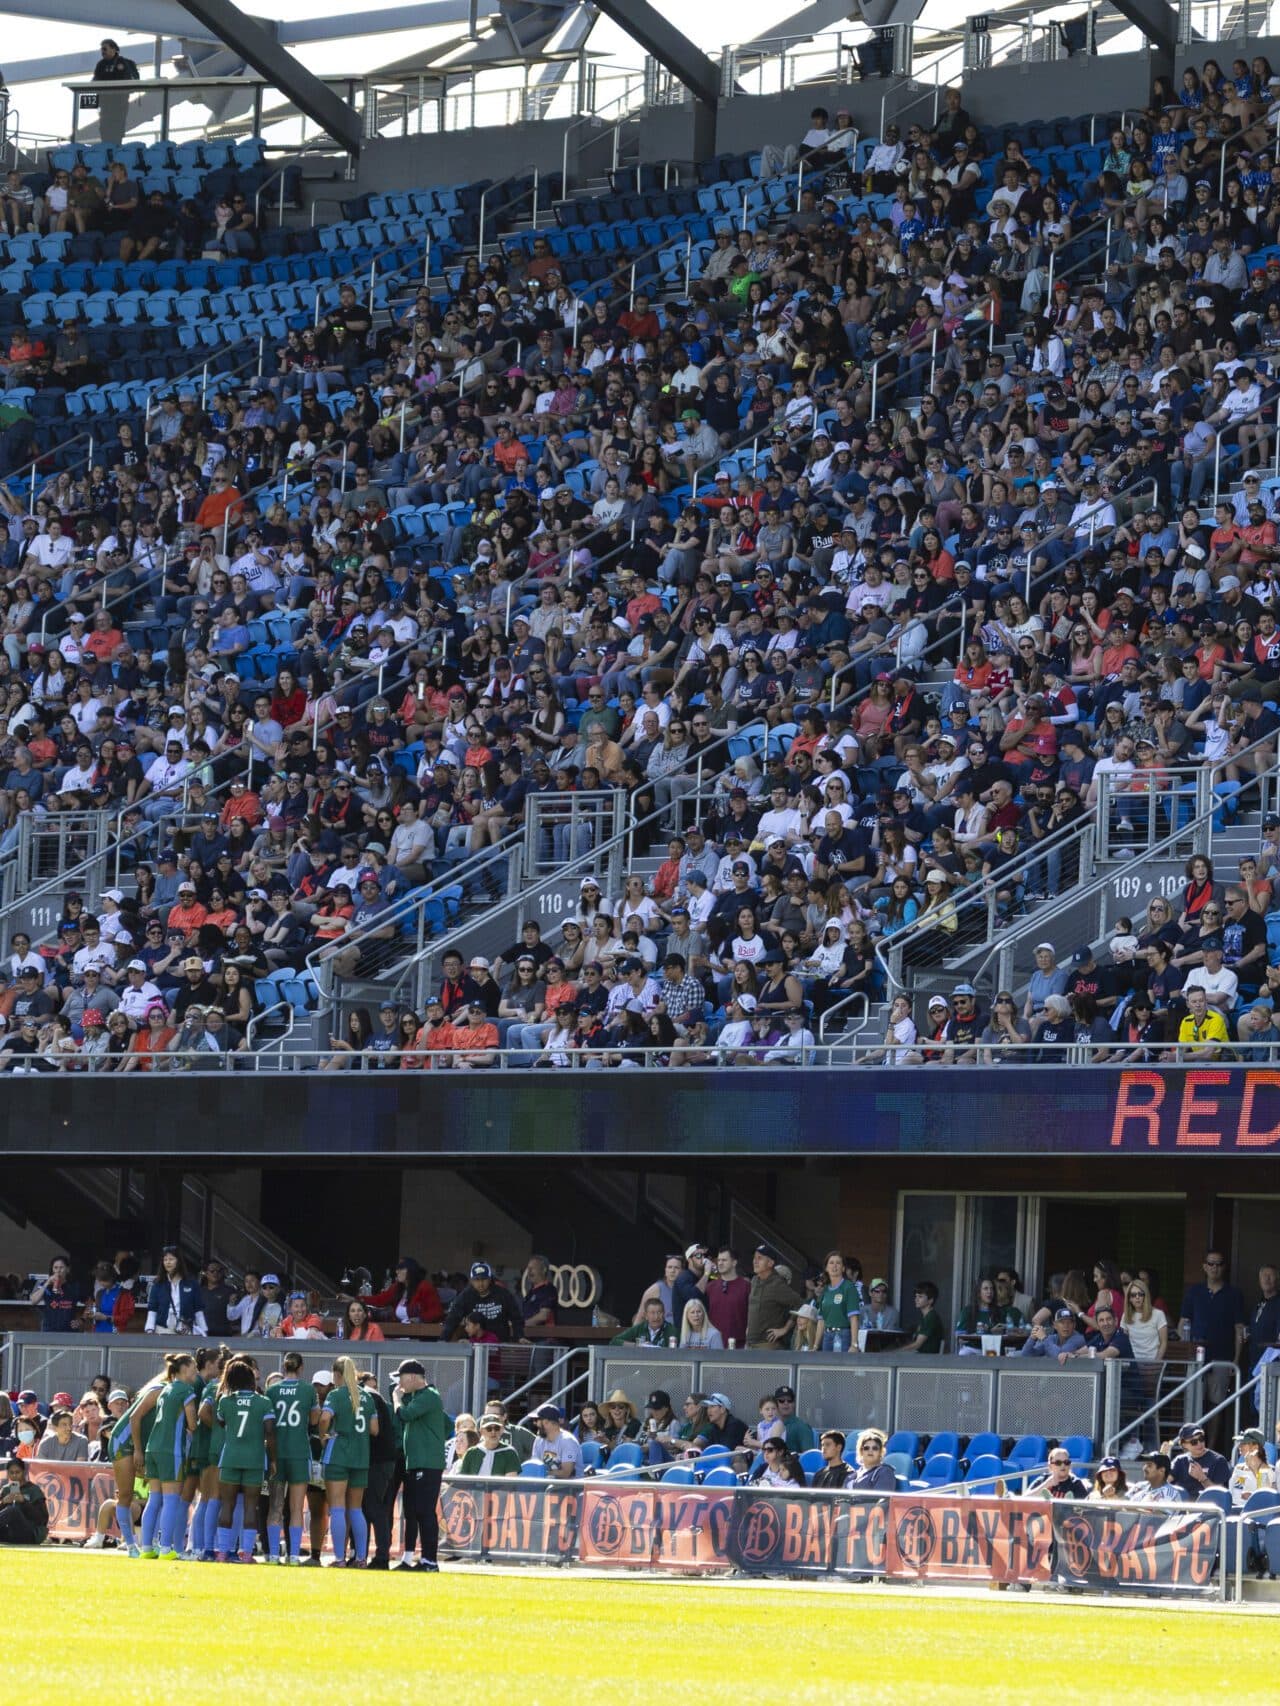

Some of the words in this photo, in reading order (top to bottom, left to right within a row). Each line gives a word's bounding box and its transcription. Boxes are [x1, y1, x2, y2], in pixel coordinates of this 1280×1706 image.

[883, 28, 895, 38] 112
[83, 96, 97, 105] 112
[1113, 876, 1140, 898] 109
[538, 893, 562, 914] 110
[30, 907, 51, 927] 111
[237, 1398, 251, 1407] OKE
[279, 1388, 297, 1396] FLINT
[236, 1411, 249, 1438] 7
[276, 1400, 301, 1427] 26
[354, 1406, 367, 1433] 5
[482, 1491, 537, 1549] BAY
[543, 1495, 578, 1552] FC
[782, 1503, 841, 1564] BAY
[846, 1505, 887, 1566] FC
[941, 1509, 1000, 1569] BAY
[1008, 1511, 1045, 1570] FC
[1097, 1518, 1158, 1581] BAY
[1168, 1521, 1212, 1586] FC
